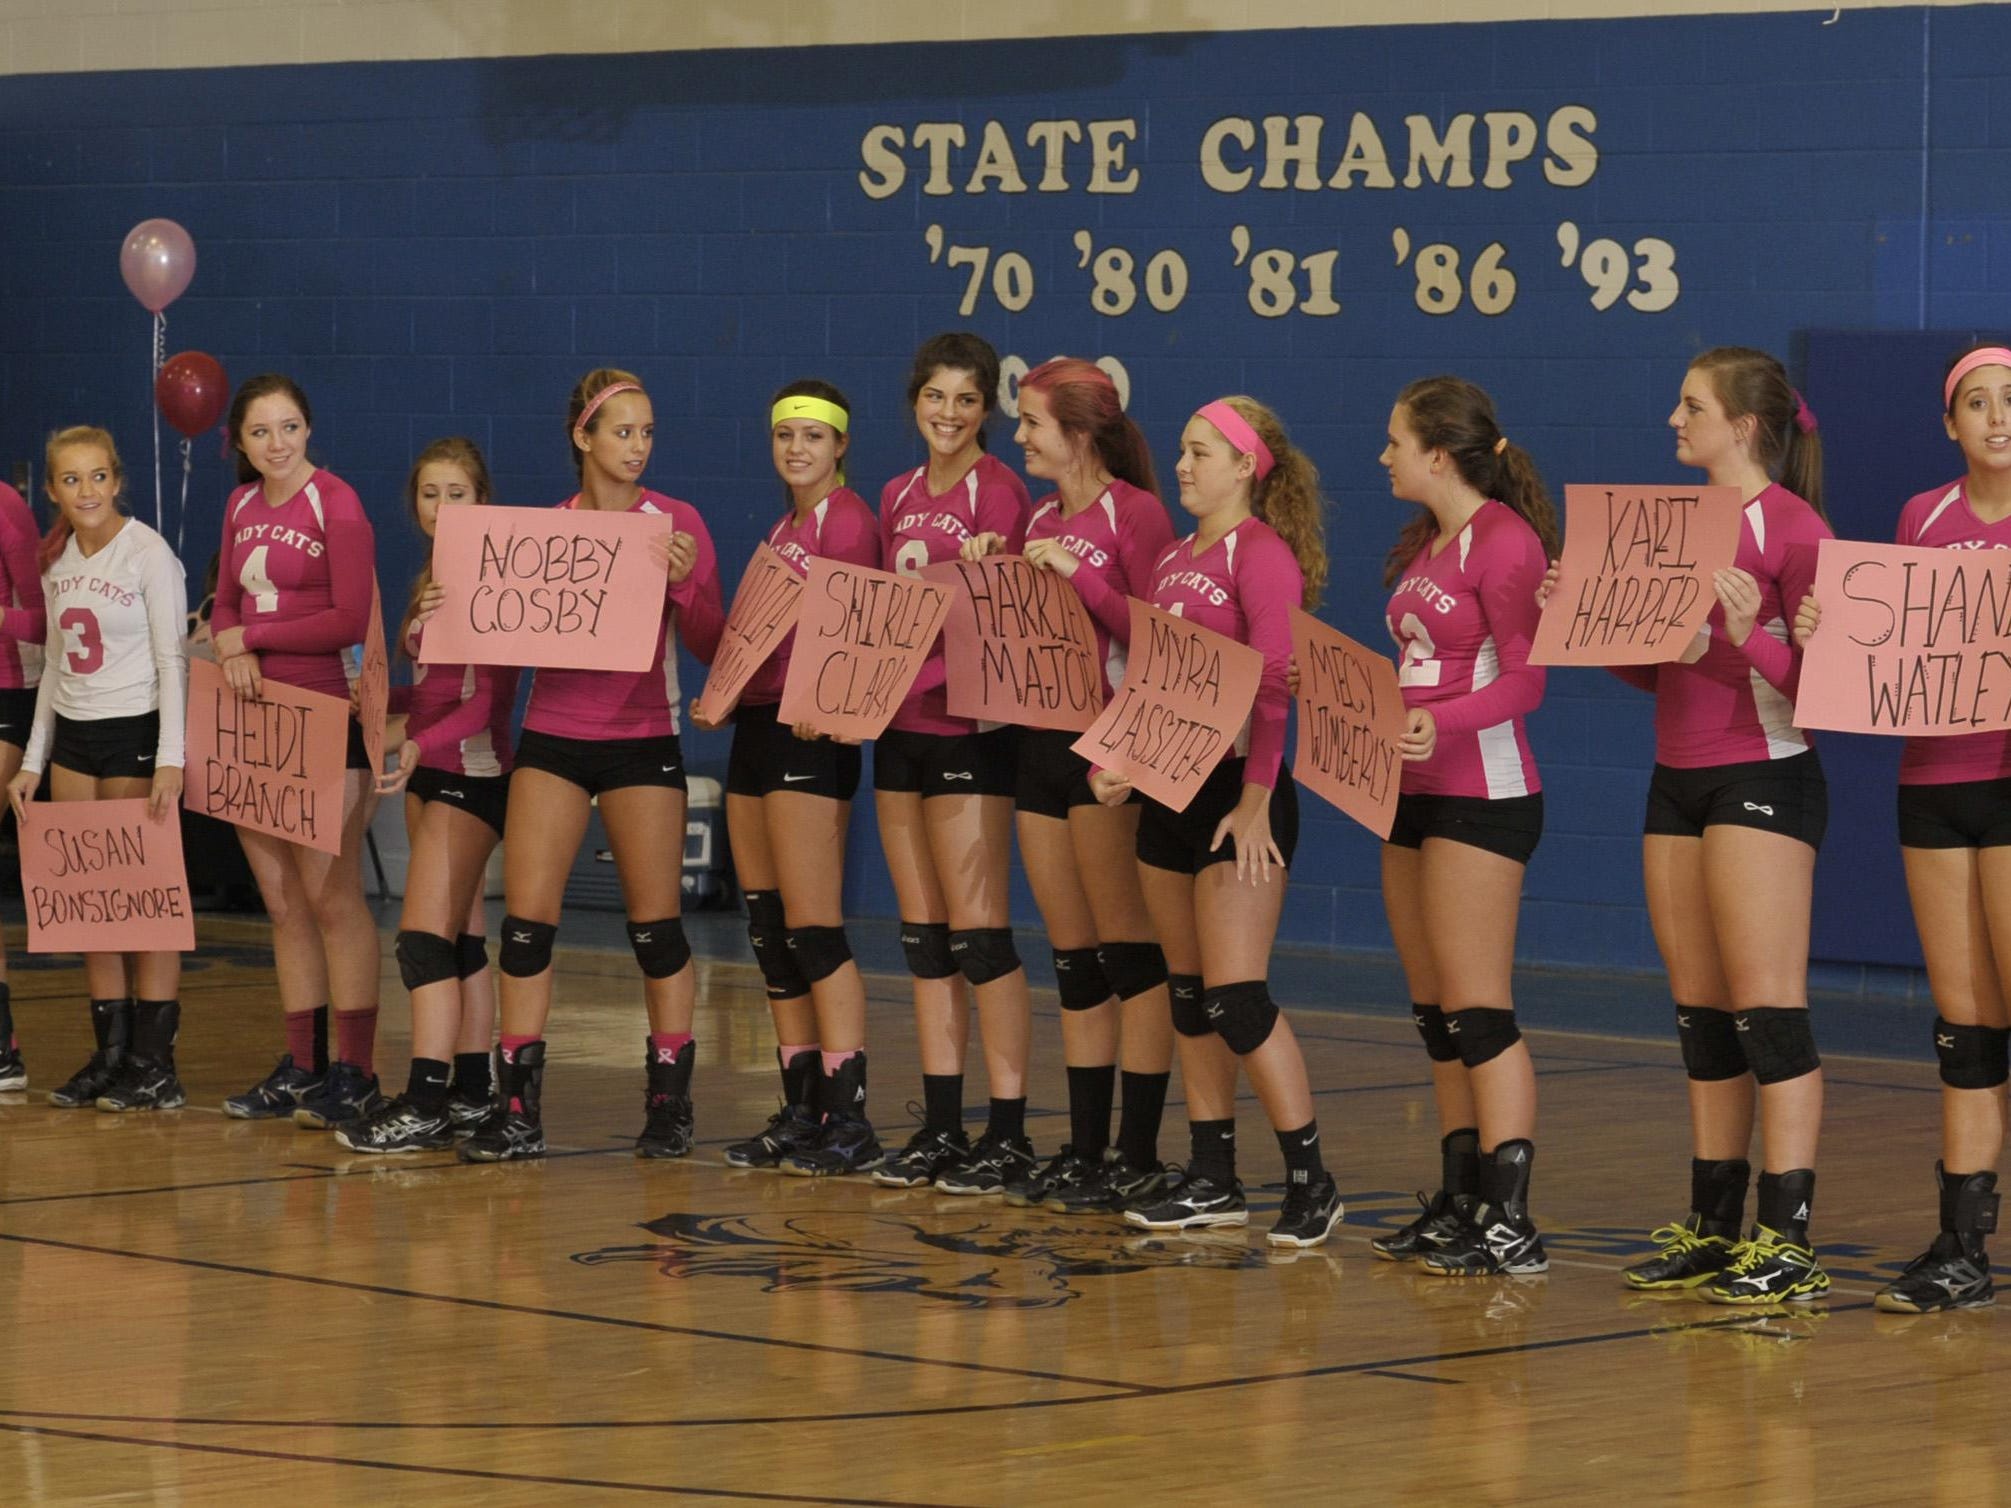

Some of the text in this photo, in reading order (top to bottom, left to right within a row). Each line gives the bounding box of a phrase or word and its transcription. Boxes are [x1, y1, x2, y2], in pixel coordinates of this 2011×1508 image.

[858, 104, 1599, 200] STATE CHAMPS
[925, 220, 1681, 319] '70 '80 '81 '86 '93
[270, 525, 325, 558] CATS
[479, 529, 622, 584] NOBBY
[931, 513, 974, 543] CATS
[1061, 534, 1109, 567] CATS
[1601, 487, 1699, 577] KARI
[88, 577, 135, 608] CATS
[239, 544, 279, 613] 4
[469, 584, 608, 637] COSBY
[818, 570, 946, 651] SHIRLEY
[1180, 571, 1229, 607] CATS
[1415, 576, 1458, 614] CATS
[1564, 574, 1700, 650] HARPER
[59, 606, 104, 675] 3
[1142, 617, 1222, 707] MYRA
[815, 650, 908, 719] CLARK
[216, 687, 313, 779] HEIDI
[1305, 699, 1396, 806] WIMBERLY
[206, 757, 317, 840] BRANCH
[44, 824, 146, 877] SUSAN
[31, 885, 184, 931] BONSIGNORE
